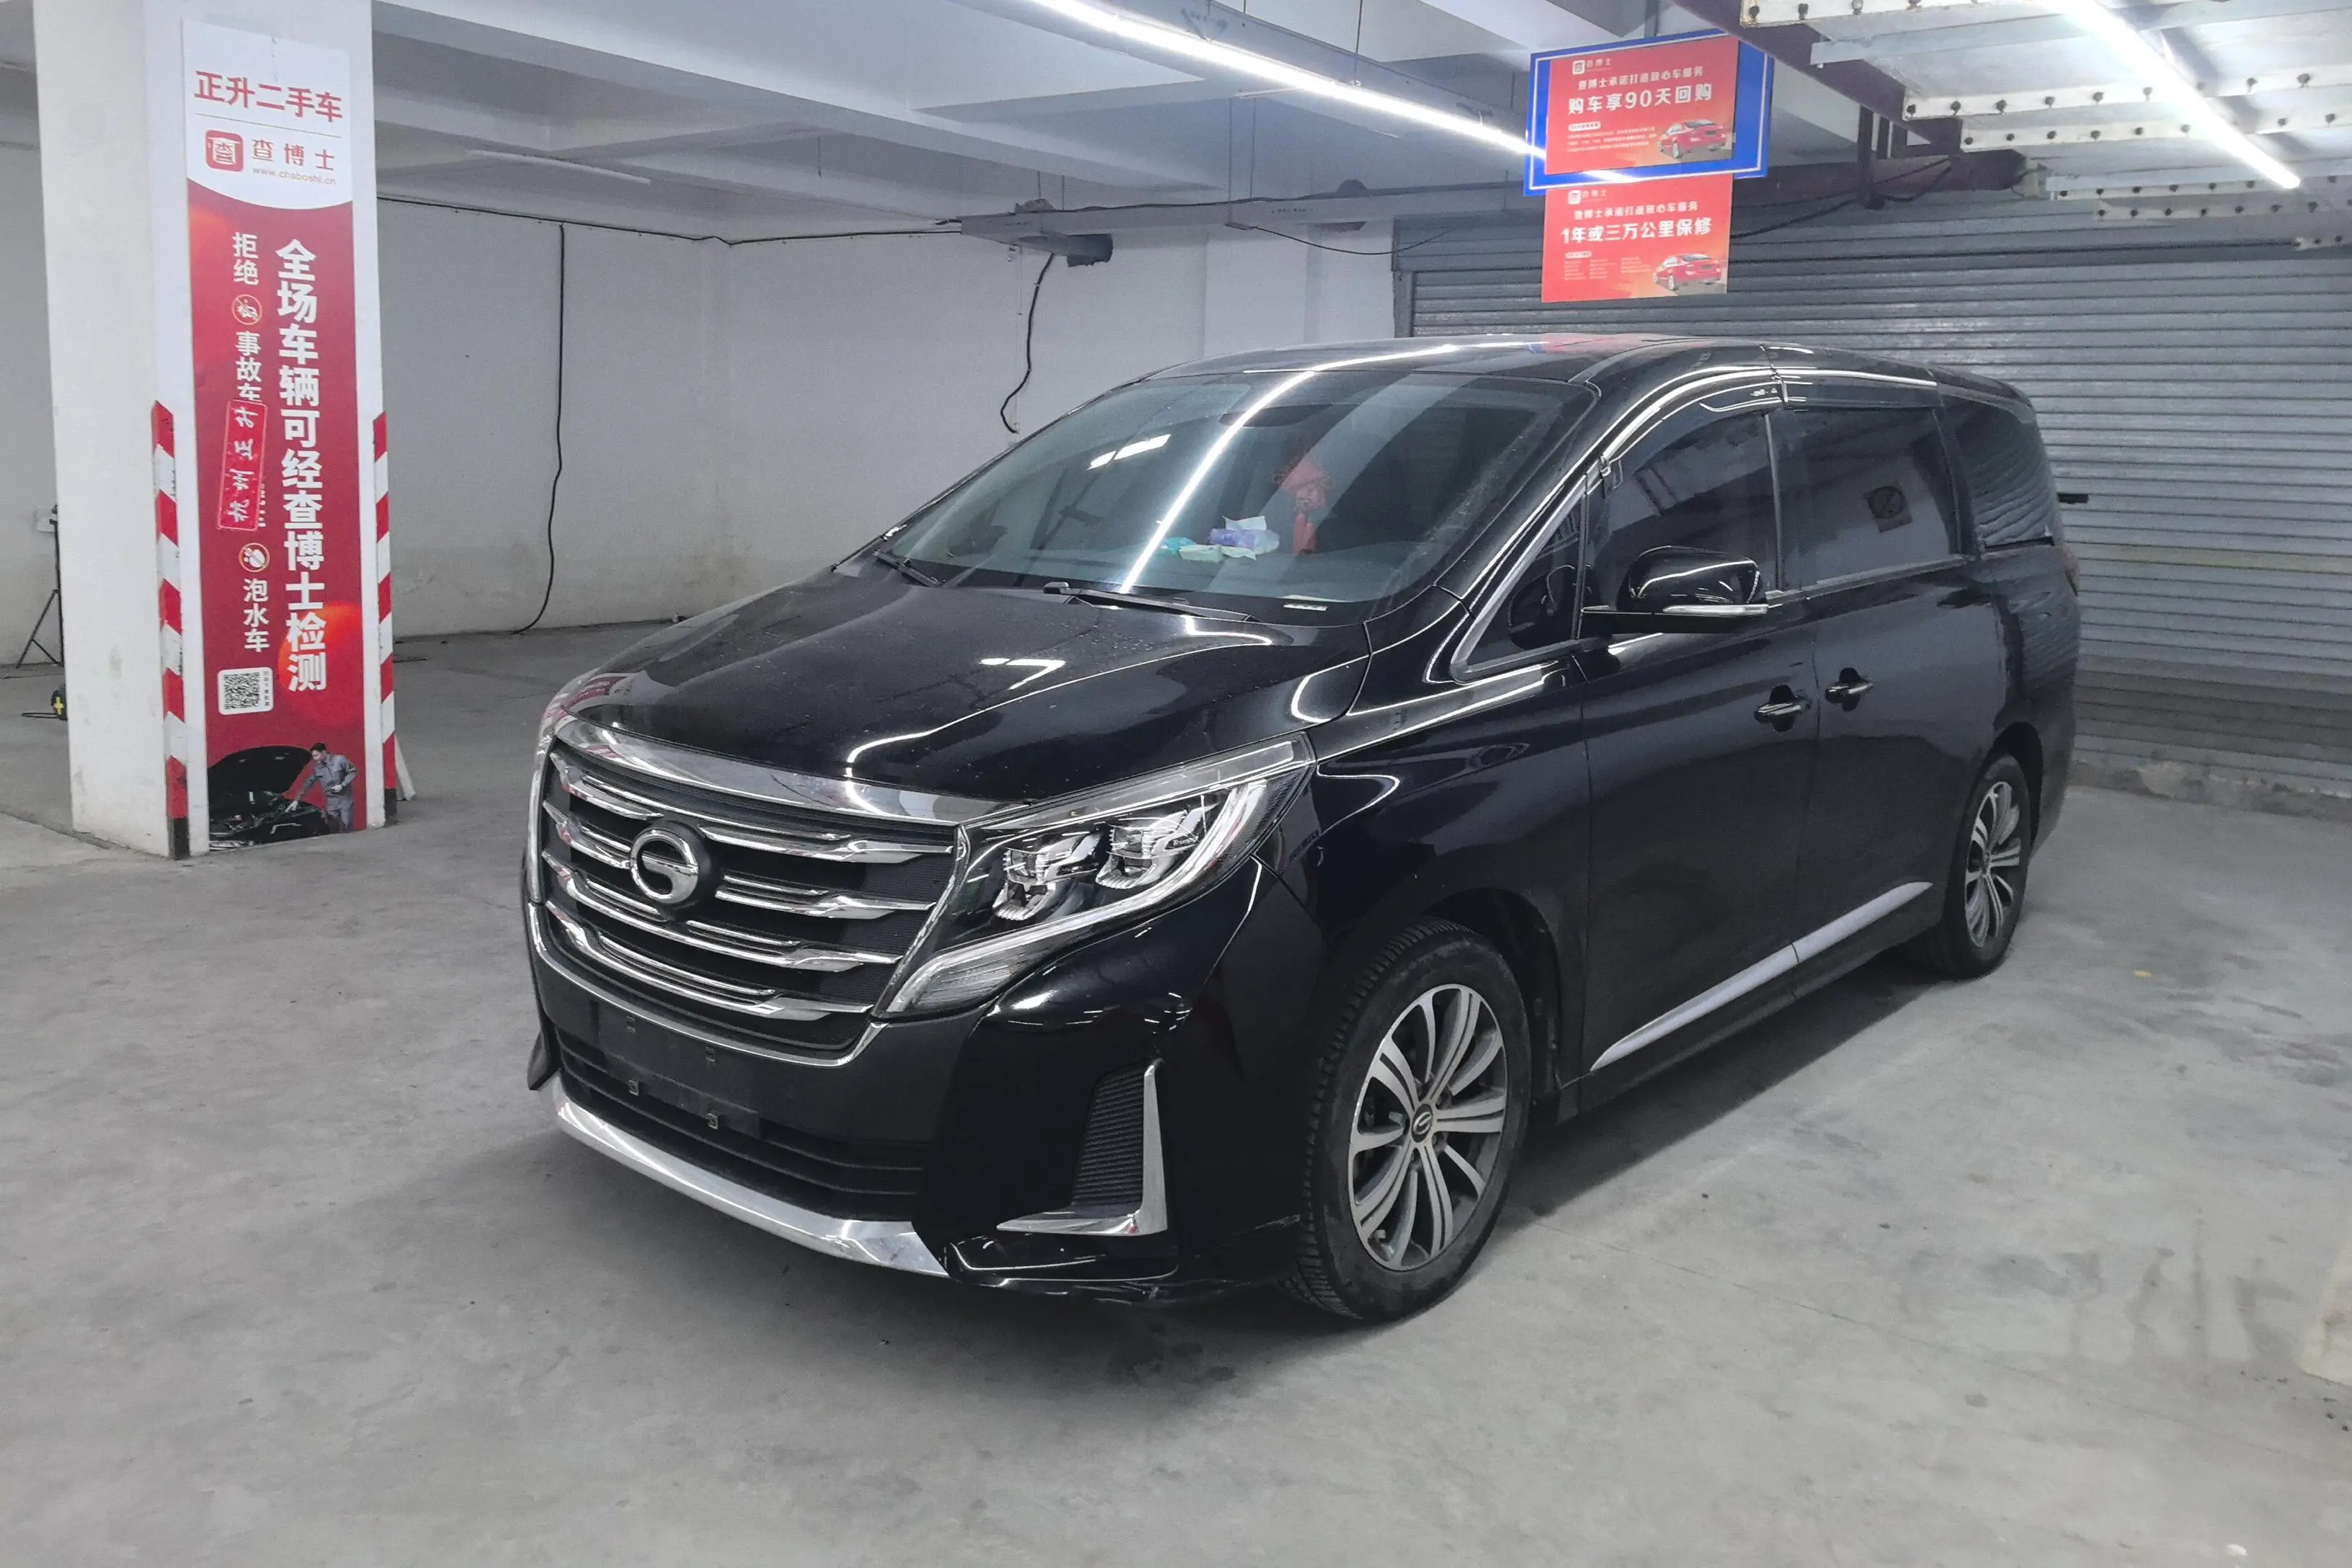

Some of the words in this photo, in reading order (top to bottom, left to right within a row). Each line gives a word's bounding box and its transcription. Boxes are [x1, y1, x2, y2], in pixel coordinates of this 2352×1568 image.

[194, 71, 342, 122] 正升二手车
[1568, 84, 1712, 115] 购车享90天回购
[252, 139, 334, 171] 查博士
[1561, 217, 1712, 244] 1年或三万公里保修
[232, 231, 259, 285] 拒绝
[235, 331, 262, 402] 事故车
[275, 239, 326, 692] 全场车辆可经查博士检测
[243, 578, 270, 653] 泡水车
